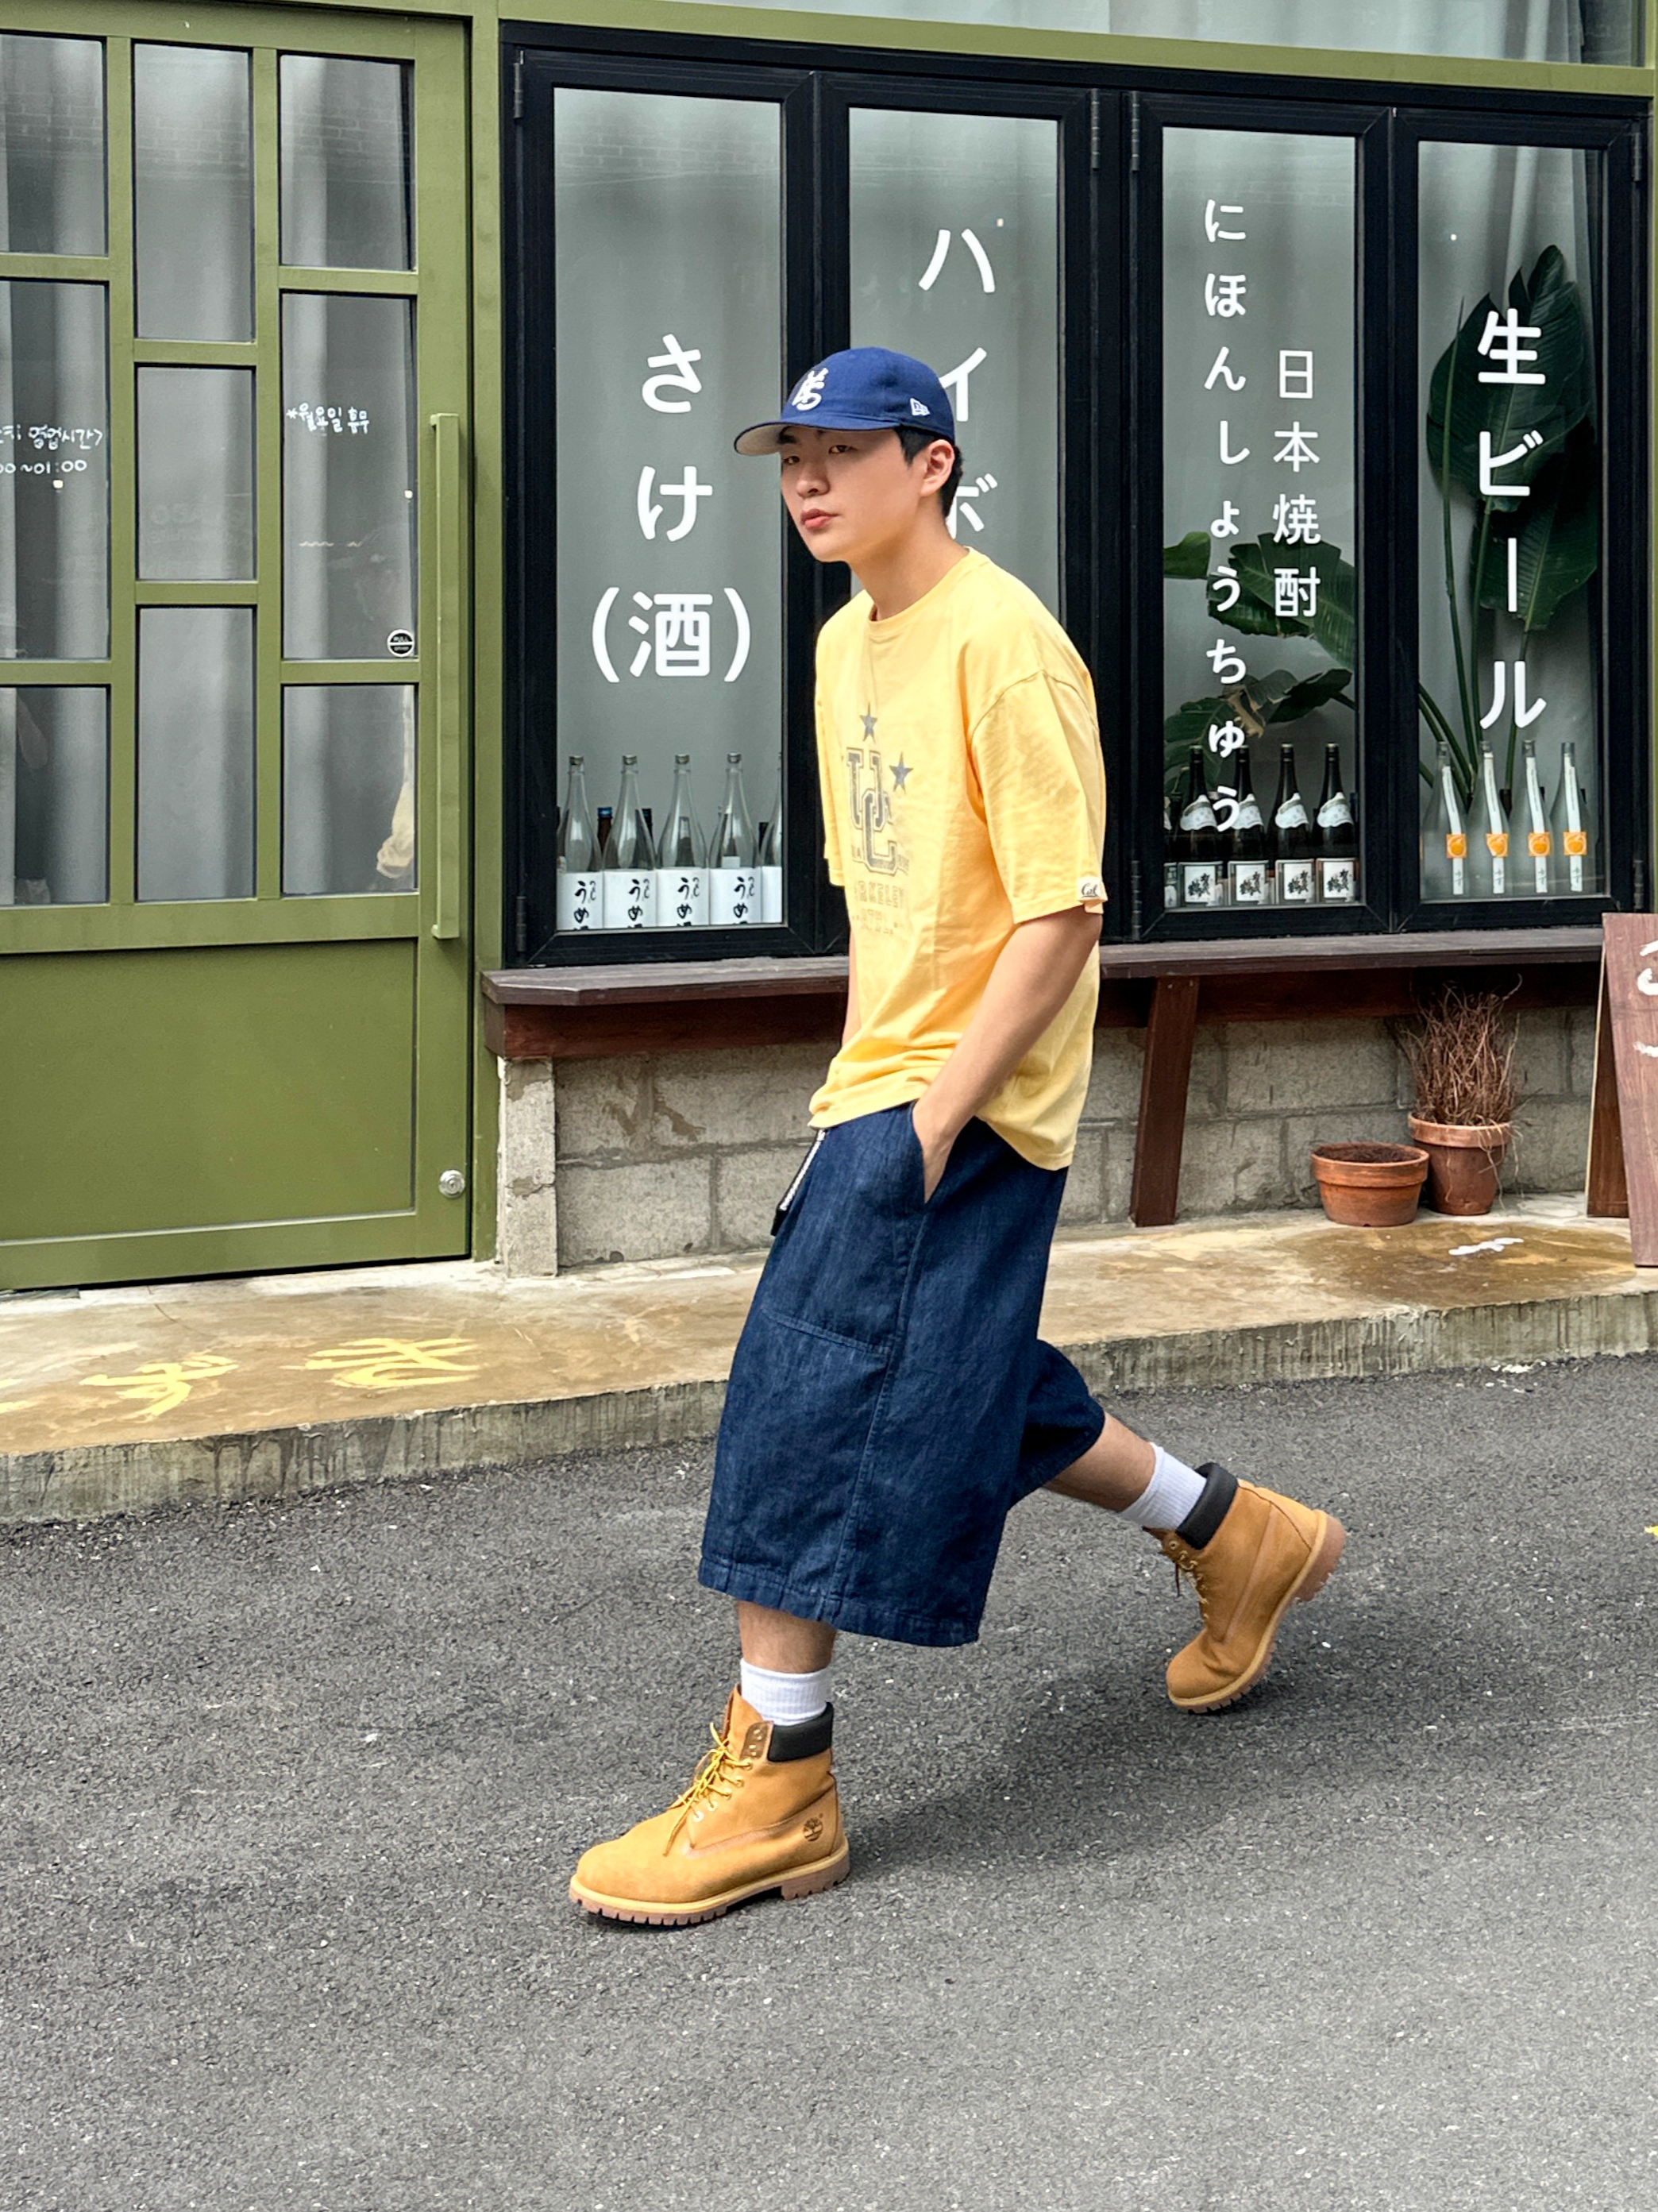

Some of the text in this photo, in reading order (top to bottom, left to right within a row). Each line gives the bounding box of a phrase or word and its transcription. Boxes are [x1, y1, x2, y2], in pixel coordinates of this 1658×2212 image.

[1204, 199, 1251, 832] にほんしょうちゅう
[1272, 350, 1321, 617] 日本焼酎
[1477, 308, 1547, 729] 生ビール
